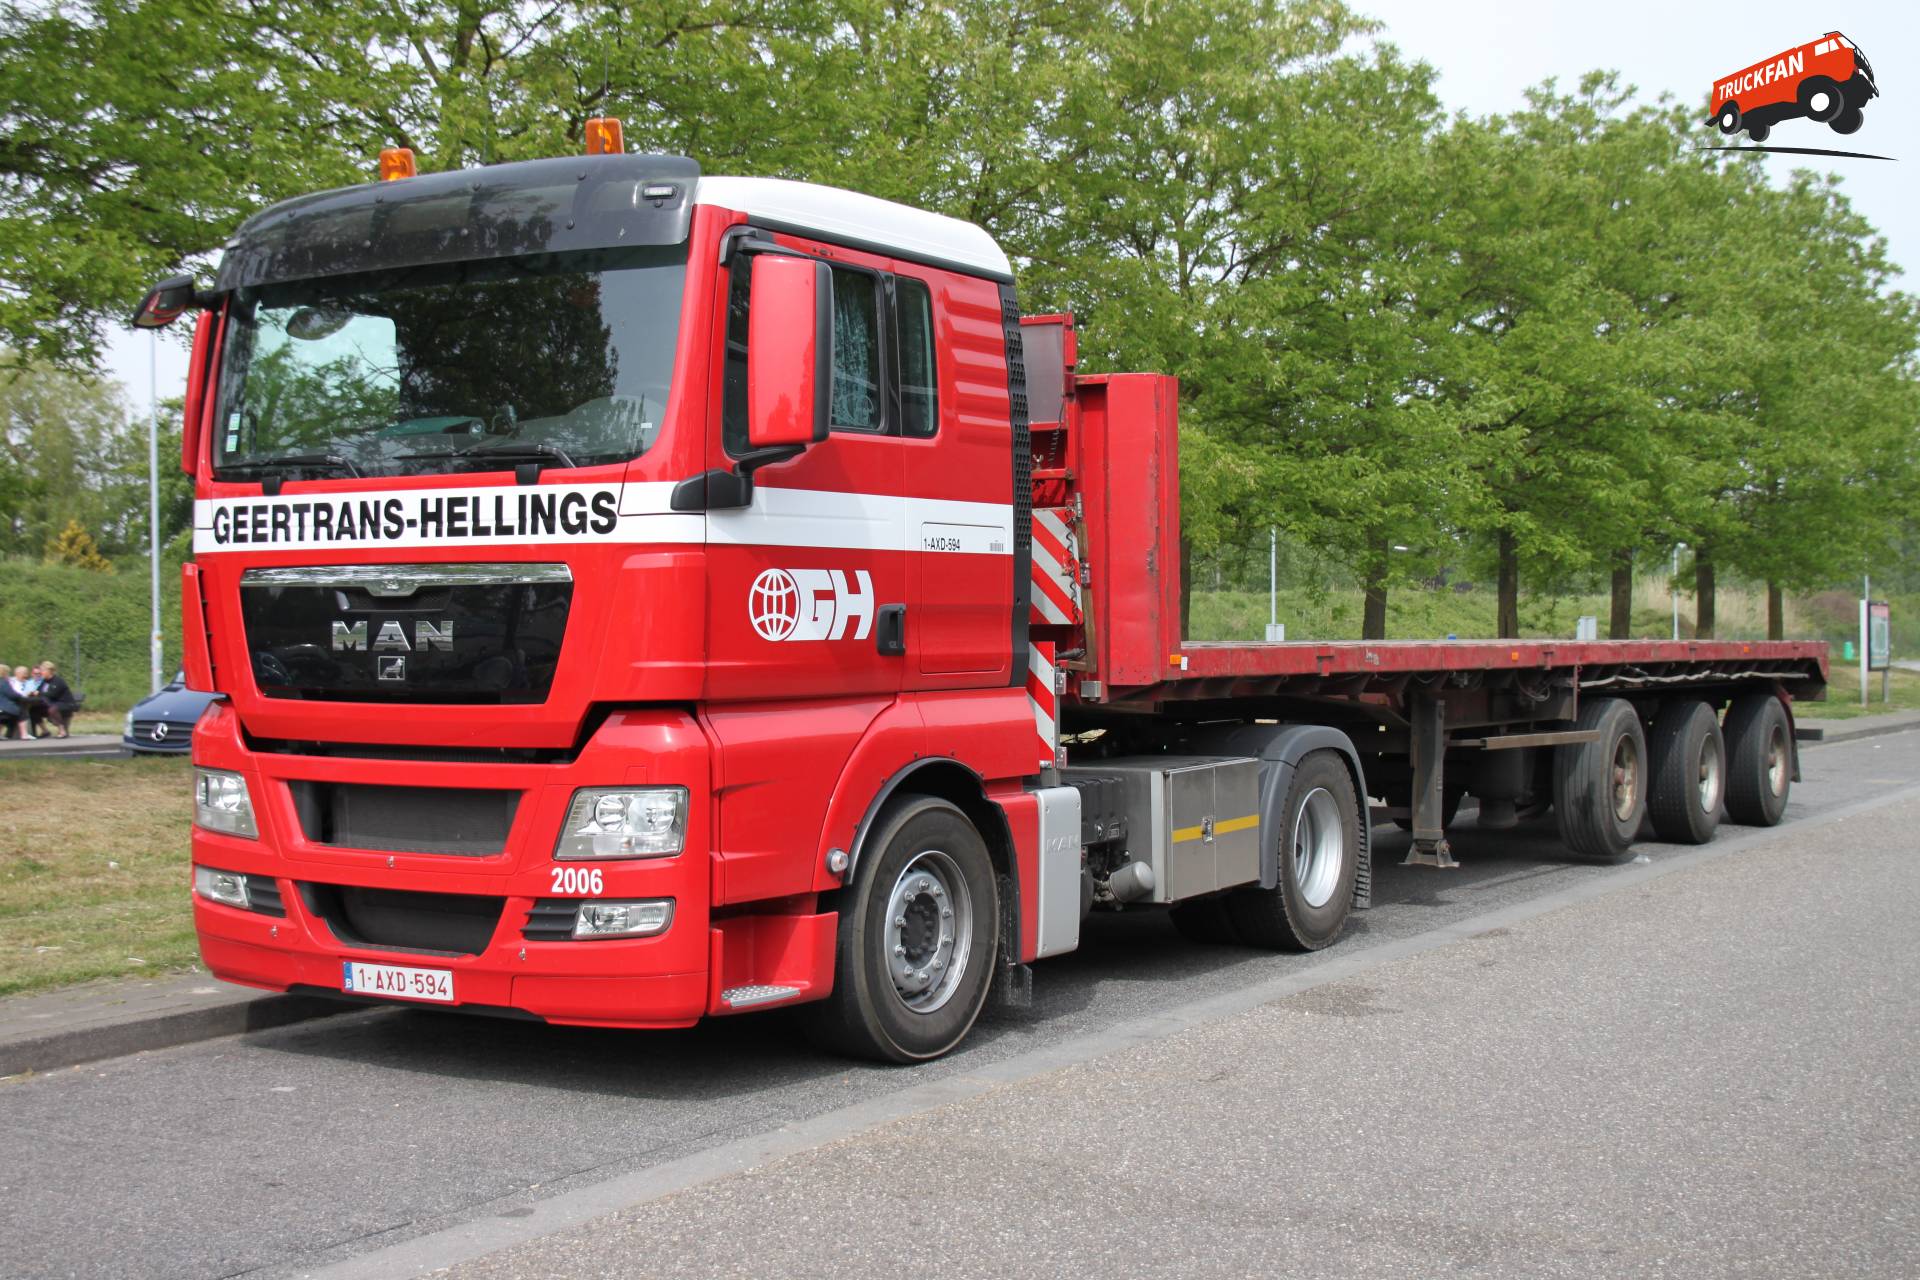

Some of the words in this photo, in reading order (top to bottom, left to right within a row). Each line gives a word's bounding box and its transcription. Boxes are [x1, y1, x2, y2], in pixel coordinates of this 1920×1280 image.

[214, 491, 618, 544] GEERTRANS-HELLINGS
[924, 537, 960, 551] 1-AXD-594
[331, 620, 454, 652] MAN
[551, 867, 604, 895] 2006
[359, 968, 448, 996] 1-AXD-594
